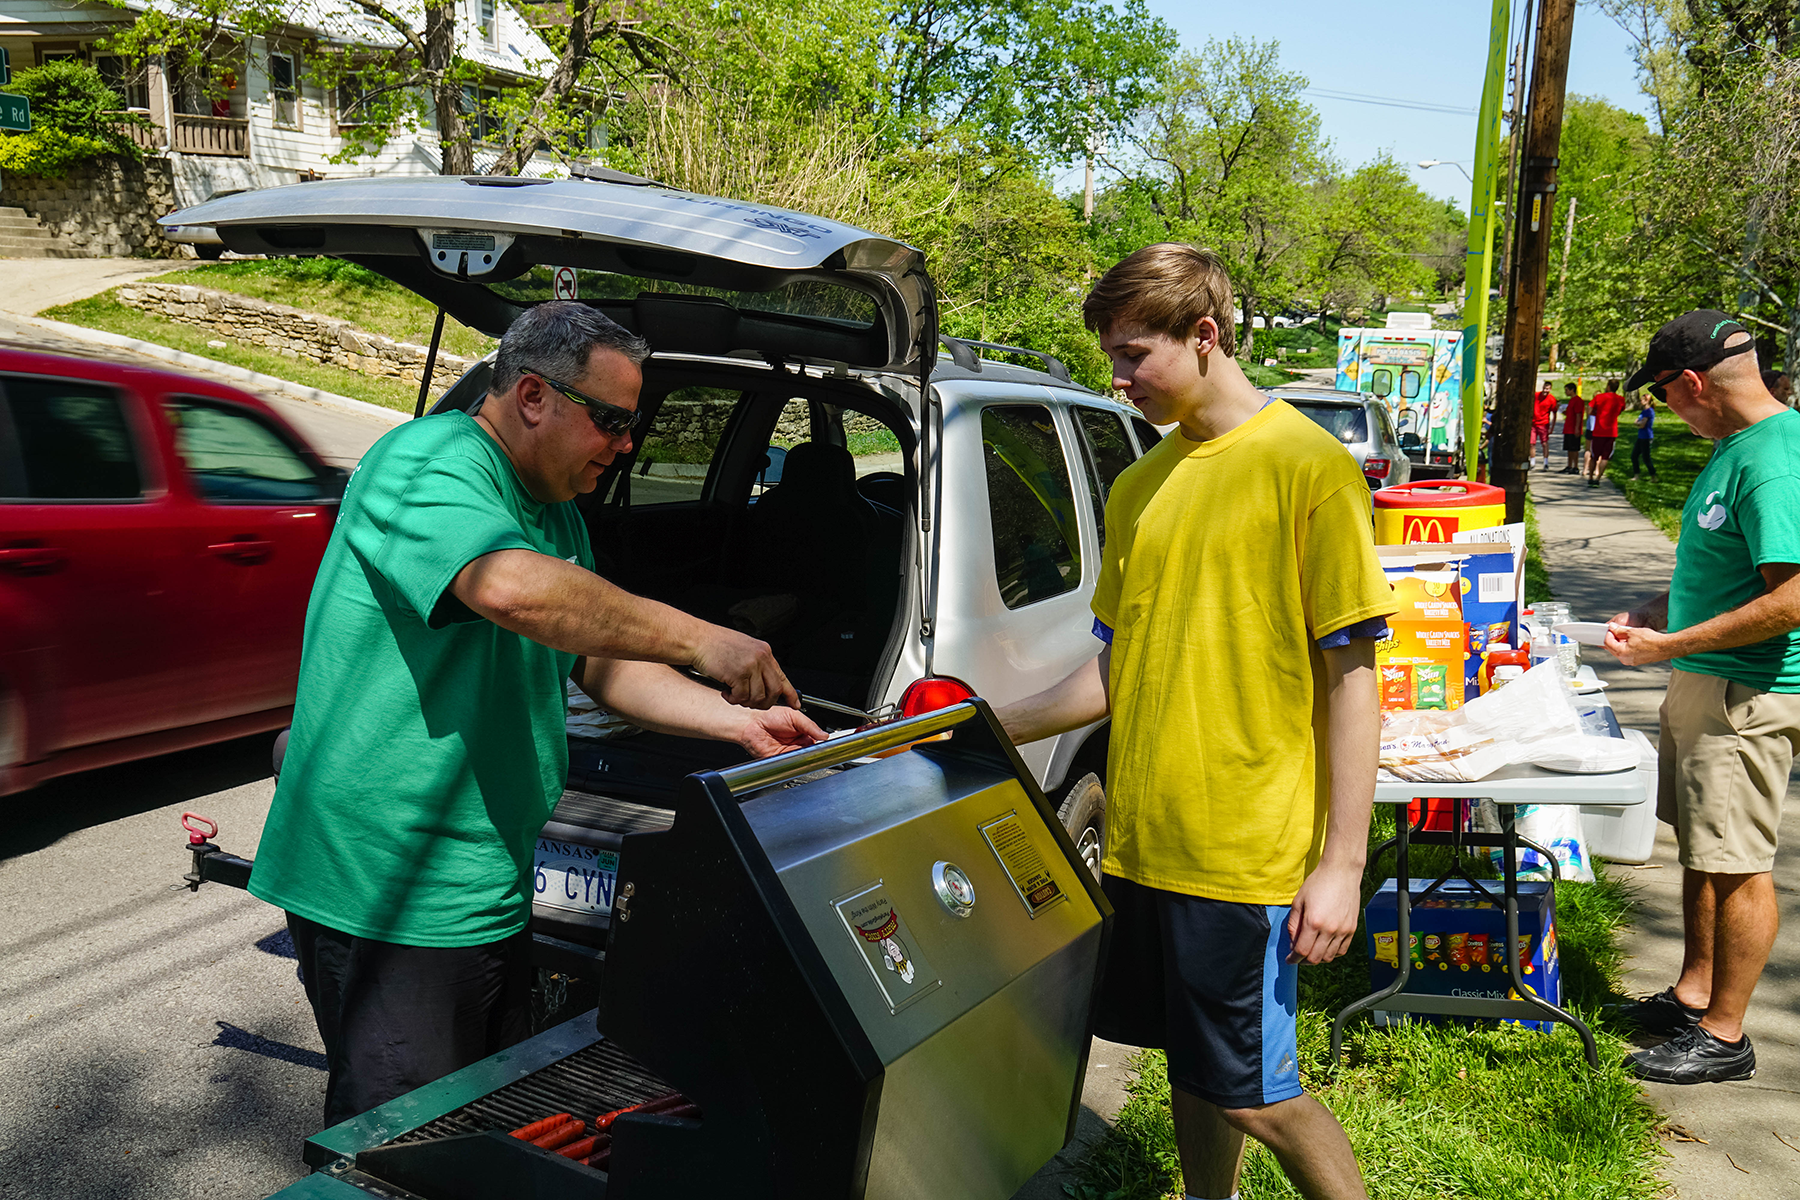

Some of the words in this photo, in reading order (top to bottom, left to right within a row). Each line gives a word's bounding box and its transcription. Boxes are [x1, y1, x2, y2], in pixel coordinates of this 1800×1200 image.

[12, 107, 25, 123] Rd
[661, 194, 832, 234] DURANGO
[534, 840, 593, 860] ANSAS
[600, 858, 615, 866] JUN
[565, 866, 612, 907] CYN
[864, 931, 881, 941] KING
[882, 920, 897, 939] PARTY
[1451, 988, 1485, 998] Classic
[1487, 989, 1506, 999] Mix
